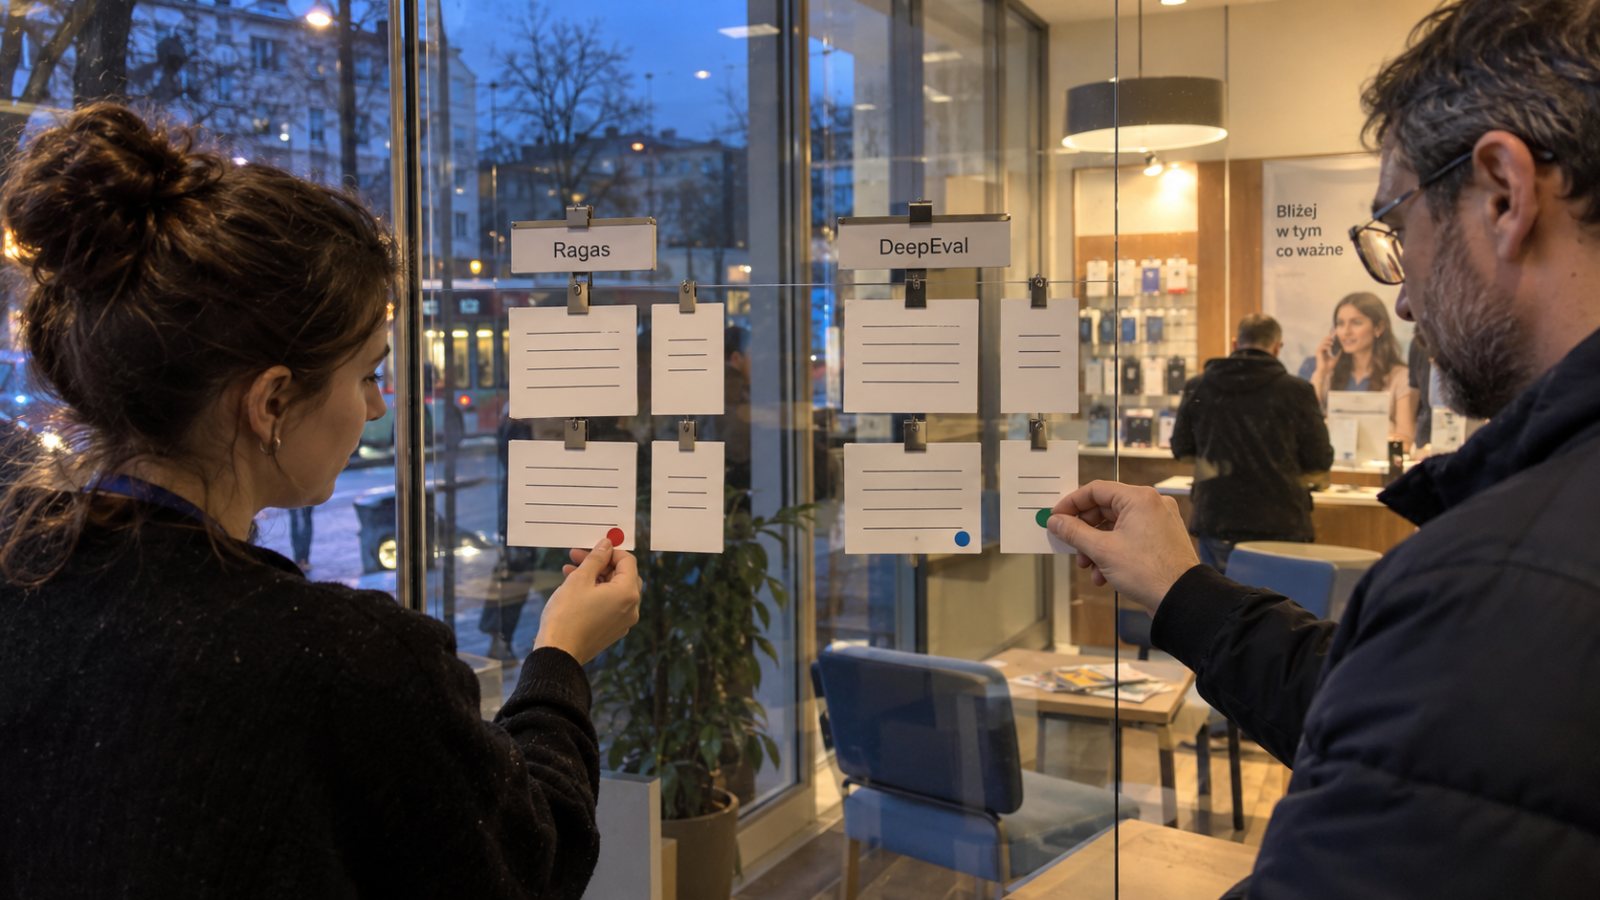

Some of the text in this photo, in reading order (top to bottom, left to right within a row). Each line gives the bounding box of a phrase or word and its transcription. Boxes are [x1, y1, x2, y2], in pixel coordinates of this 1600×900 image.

[1277, 203, 1317, 220] Bliżej
[1276, 225, 1322, 240] w tym
[554, 242, 610, 261] Ragas
[880, 237, 968, 258] DeepEval
[1276, 243, 1343, 257] co ważne
